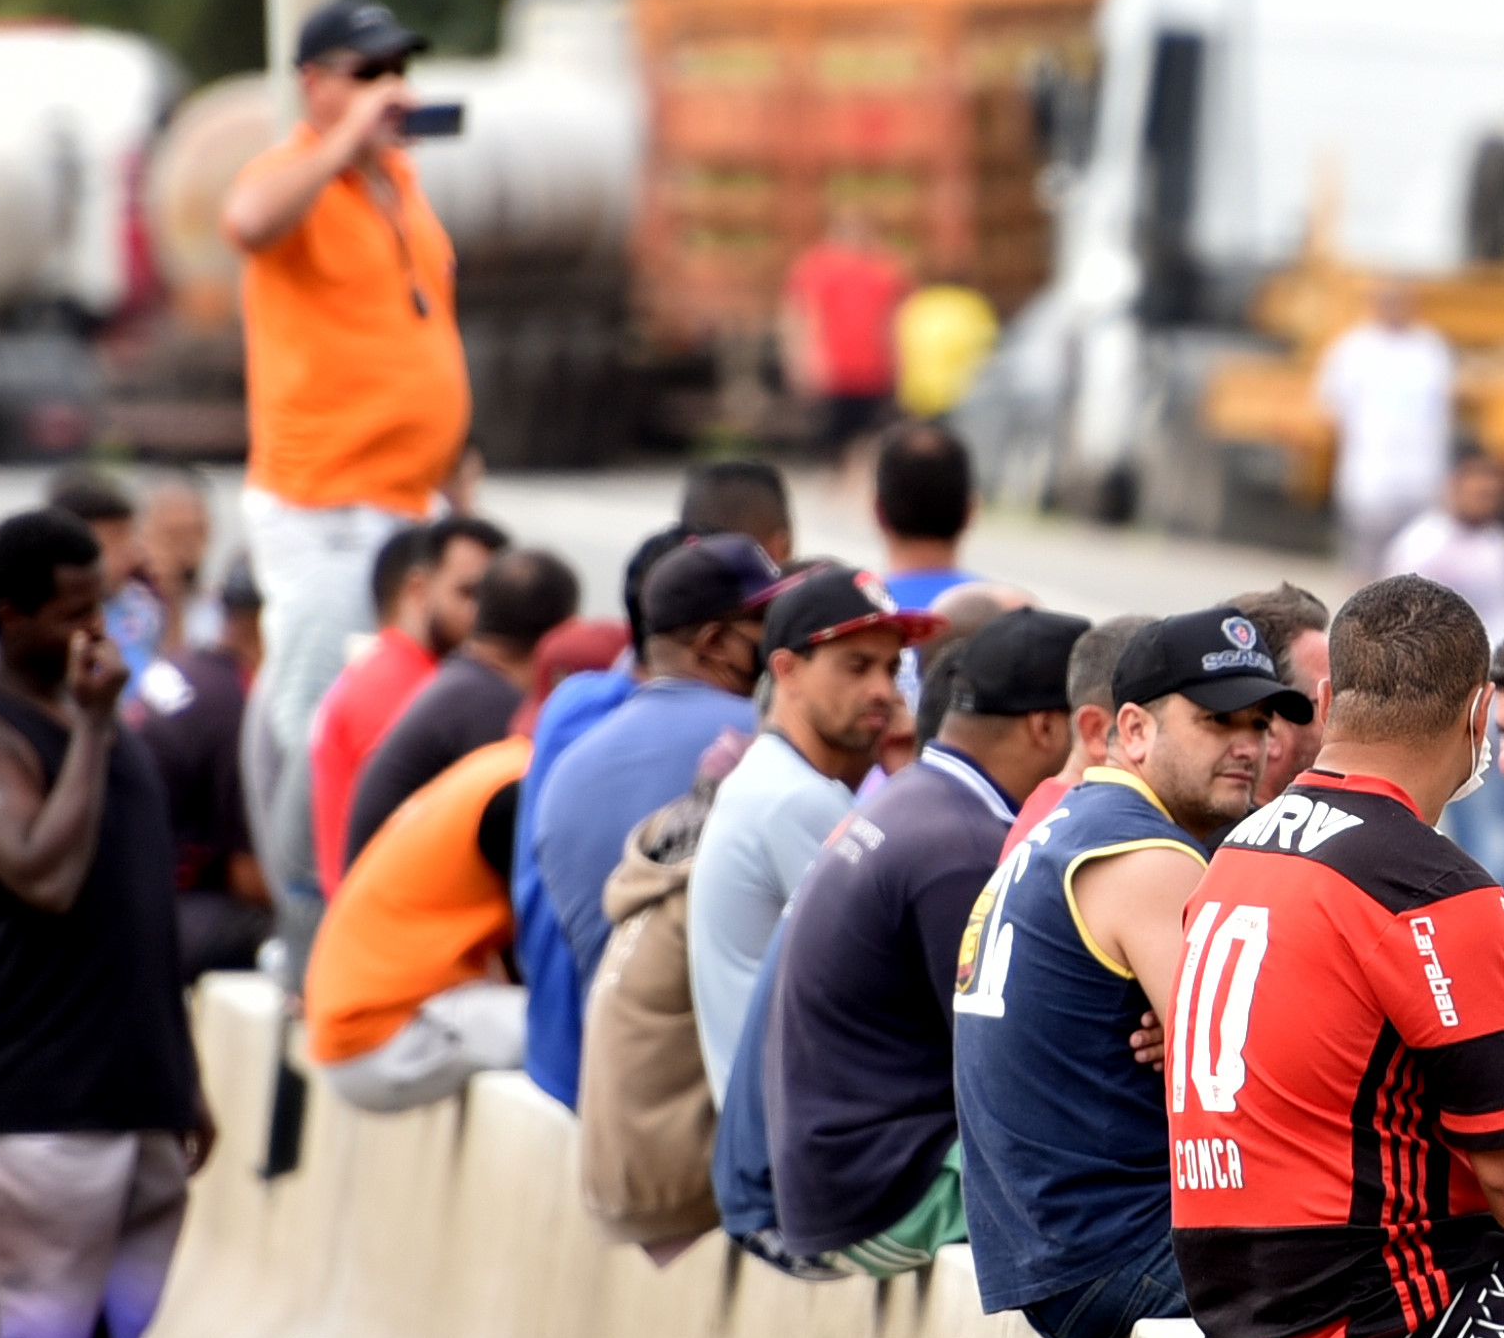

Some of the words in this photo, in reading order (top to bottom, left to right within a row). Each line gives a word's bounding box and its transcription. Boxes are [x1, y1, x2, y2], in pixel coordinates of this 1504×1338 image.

[1172, 901, 1269, 1113] 10
[1409, 916, 1459, 1027] Carabao
[1175, 1137, 1244, 1190] CONCA
